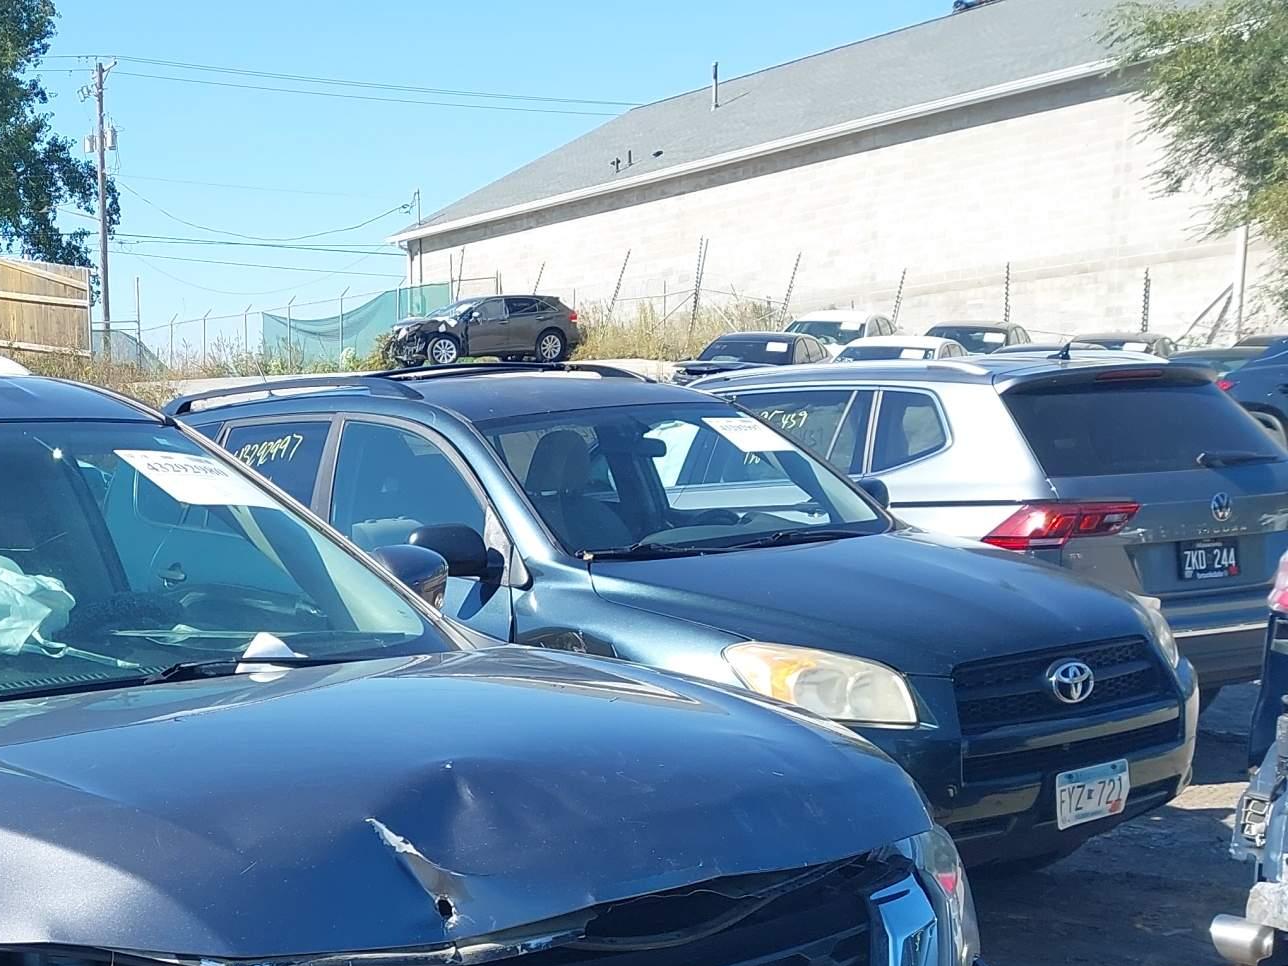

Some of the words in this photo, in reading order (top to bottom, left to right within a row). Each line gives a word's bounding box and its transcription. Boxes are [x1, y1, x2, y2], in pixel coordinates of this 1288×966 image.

[1183, 549, 1207, 570] ZKD
[1213, 547, 1236, 569] 244
[1059, 784, 1086, 817] FYZ
[1096, 775, 1123, 807] 721
